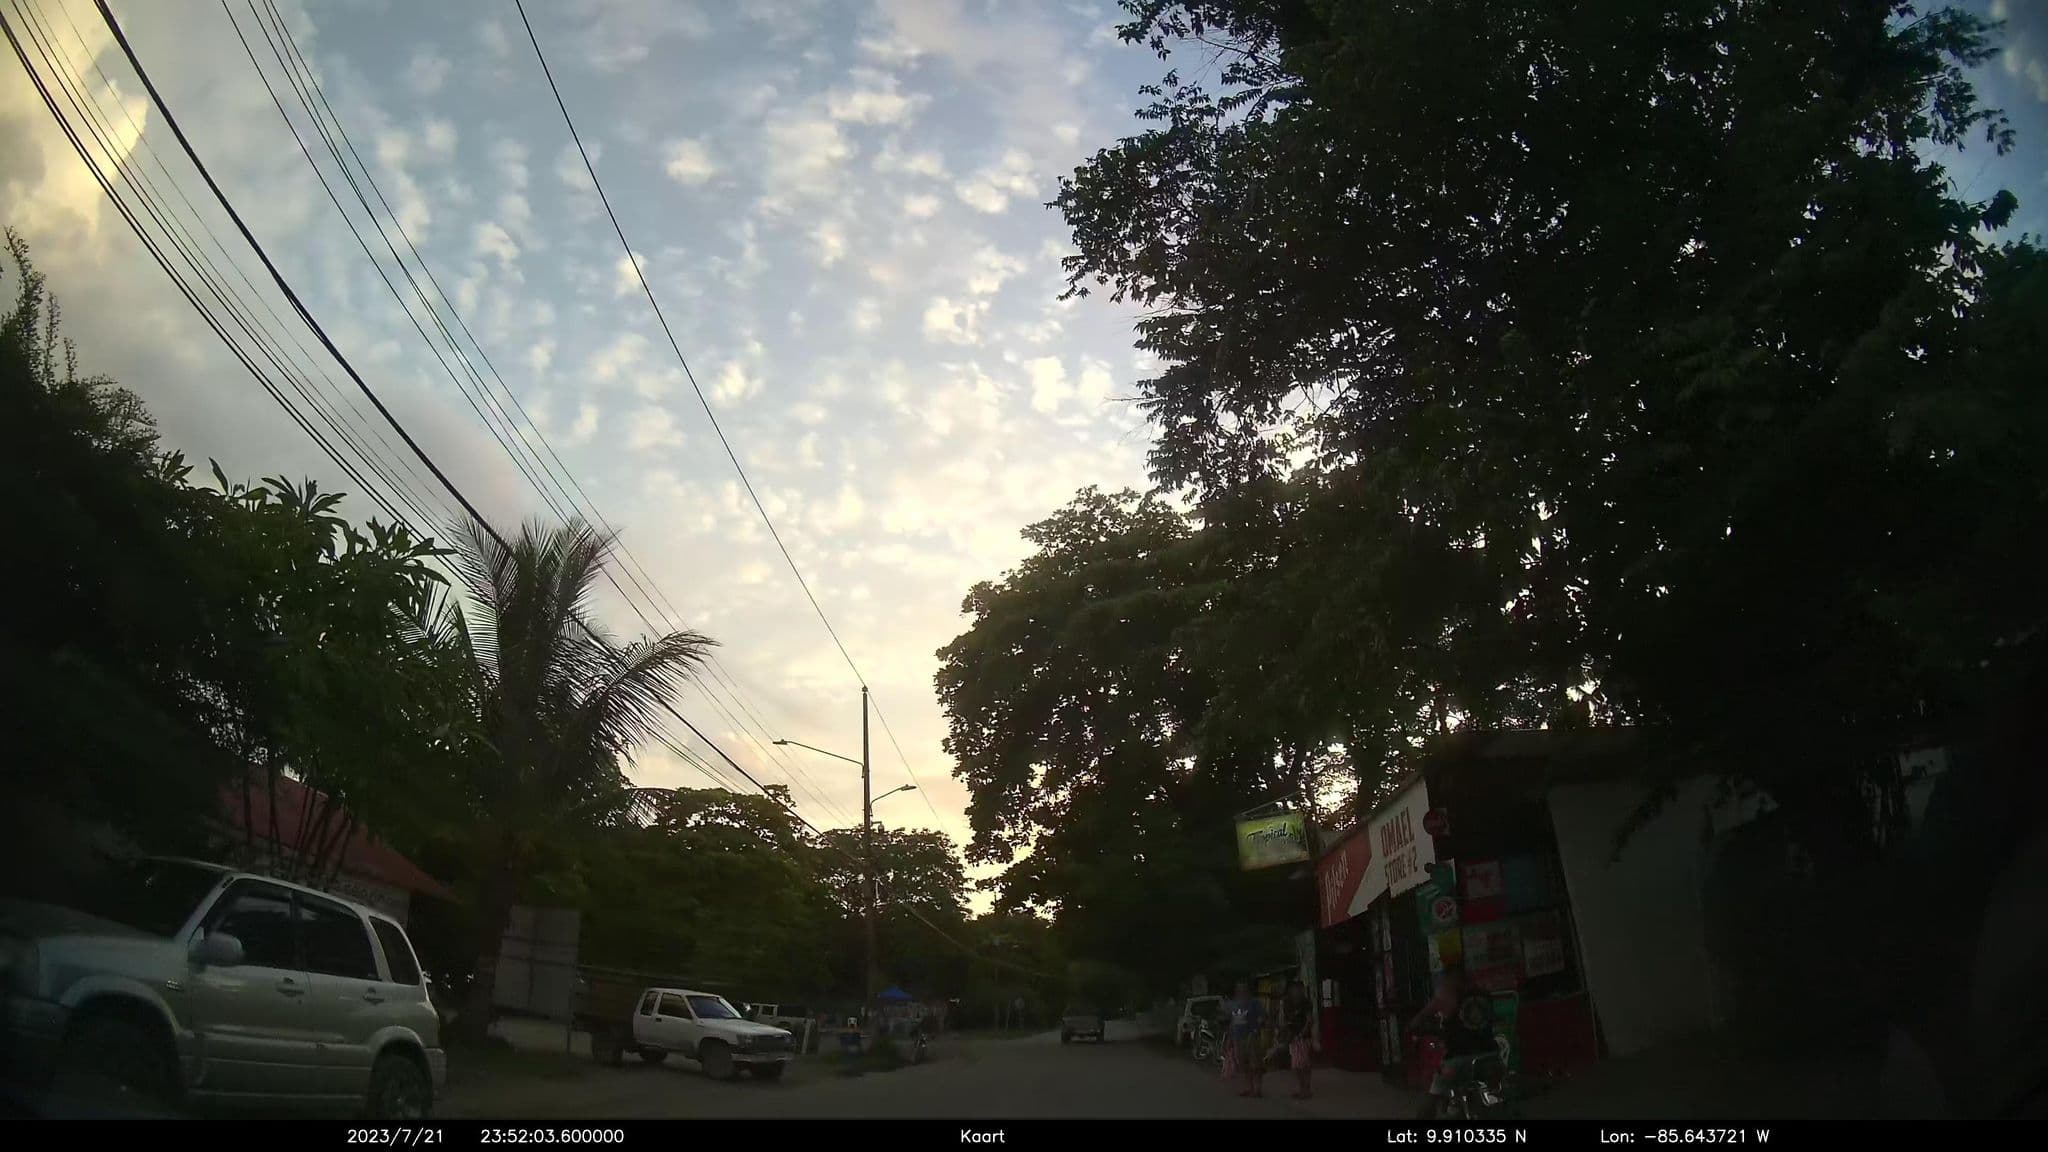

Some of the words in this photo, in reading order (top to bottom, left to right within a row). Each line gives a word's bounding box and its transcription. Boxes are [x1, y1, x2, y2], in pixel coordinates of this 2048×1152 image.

[1246, 821, 1289, 845] Trpical
[1381, 806, 1415, 858] OMAEL
[1384, 853, 1408, 886] STORE
